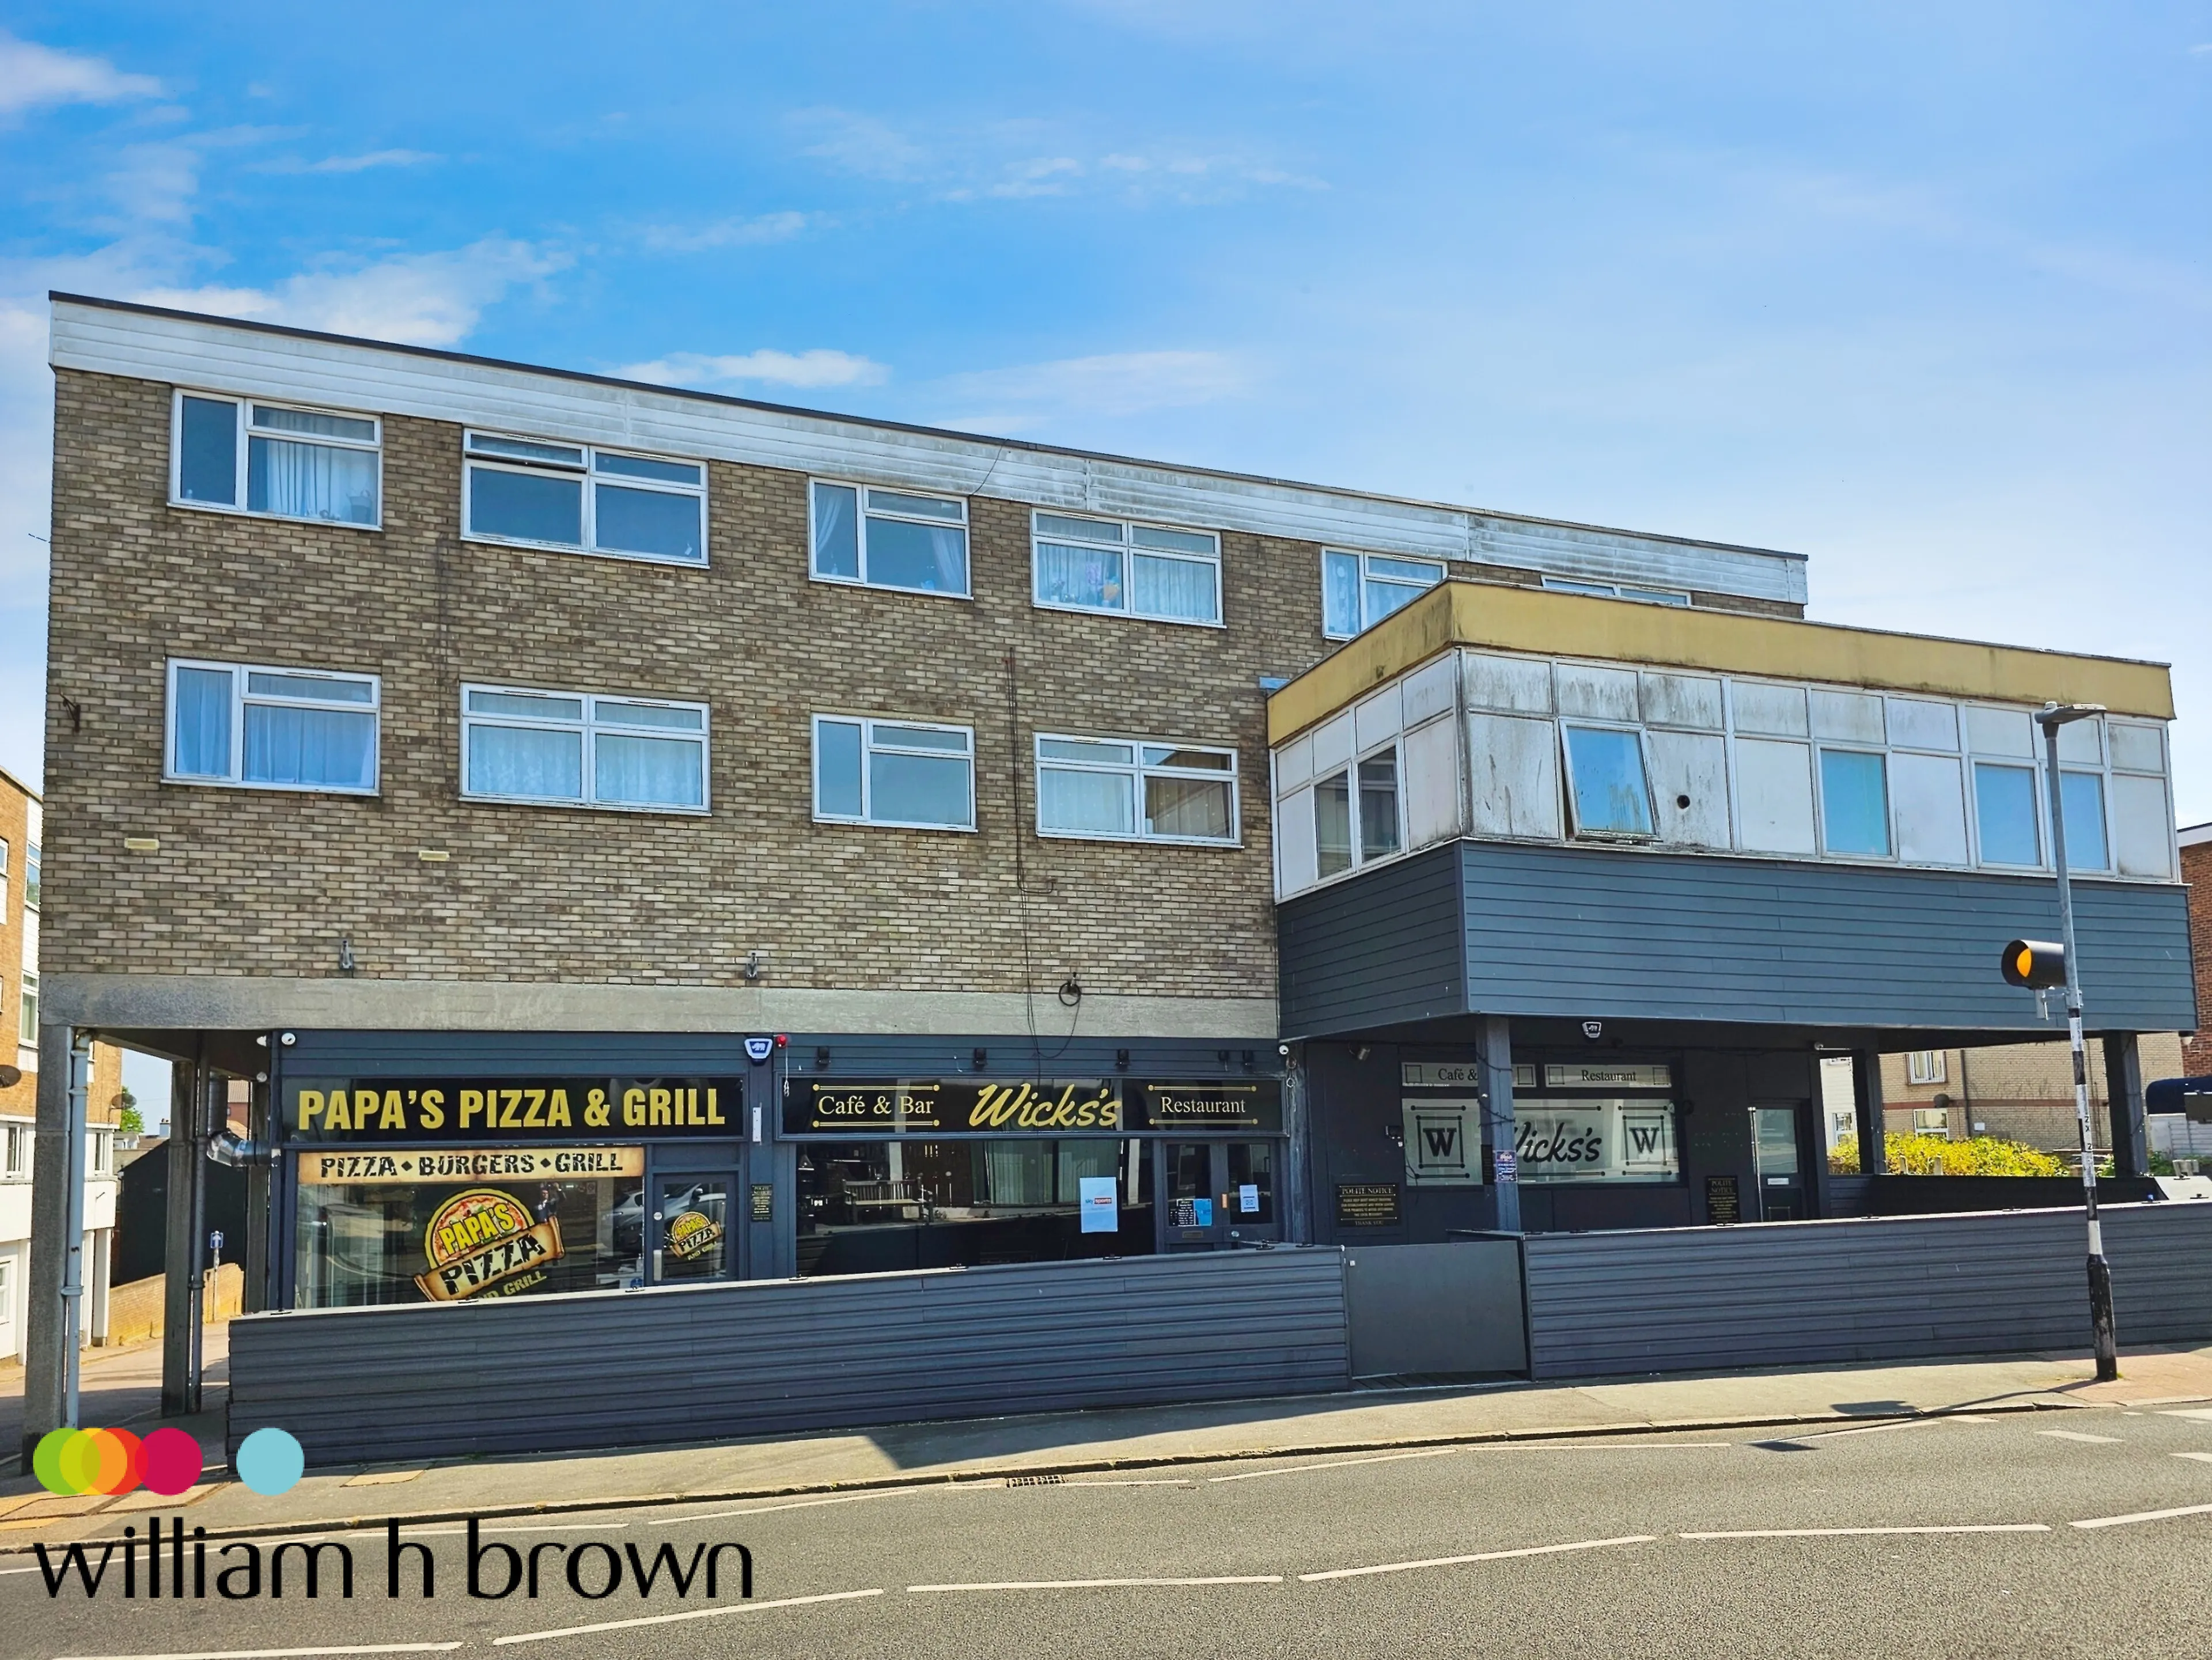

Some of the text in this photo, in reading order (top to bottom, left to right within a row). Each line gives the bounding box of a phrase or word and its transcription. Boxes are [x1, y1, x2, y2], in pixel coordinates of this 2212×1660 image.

[1438, 1067, 1478, 1081] Café &
[1581, 1069, 1637, 1081] Restaurant
[298, 1089, 725, 1130] PAPA'S PIZZA & GRILL
[819, 1096, 934, 1115] Café & Bar
[969, 1083, 1122, 1127] Wicks's
[1161, 1097, 1246, 1113] Restaurant
[1423, 1128, 1457, 1157] W
[1629, 1127, 1659, 1154] W
[321, 1153, 623, 1177] PIZZA BURGERS GRILL
[438, 1203, 515, 1255] PAPA'S
[679, 1228, 715, 1252] PIZZA
[440, 1233, 546, 1295] PIZZA
[503, 1271, 547, 1296] GRILL
